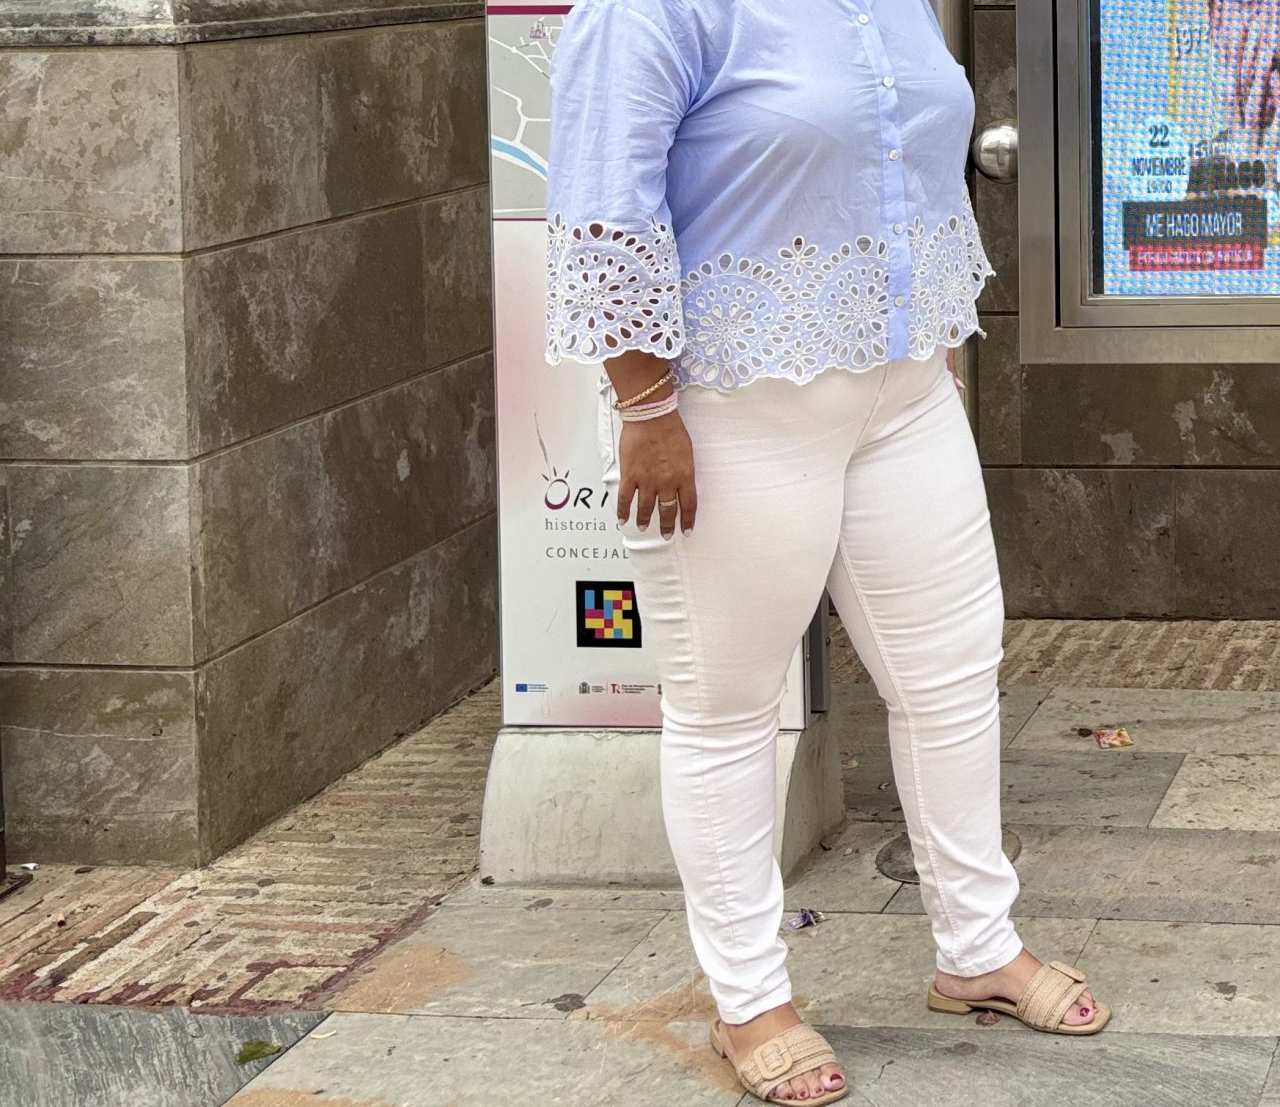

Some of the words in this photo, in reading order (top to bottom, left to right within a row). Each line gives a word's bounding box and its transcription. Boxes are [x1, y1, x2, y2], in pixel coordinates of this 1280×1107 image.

[1149, 124, 1170, 148] 22
[1132, 157, 1186, 176] NOVIEMBRE
[1146, 214, 1164, 237] ME
[1167, 214, 1198, 237] HAGO
[1200, 212, 1243, 236] MAYOR
[545, 517, 607, 531] historia
